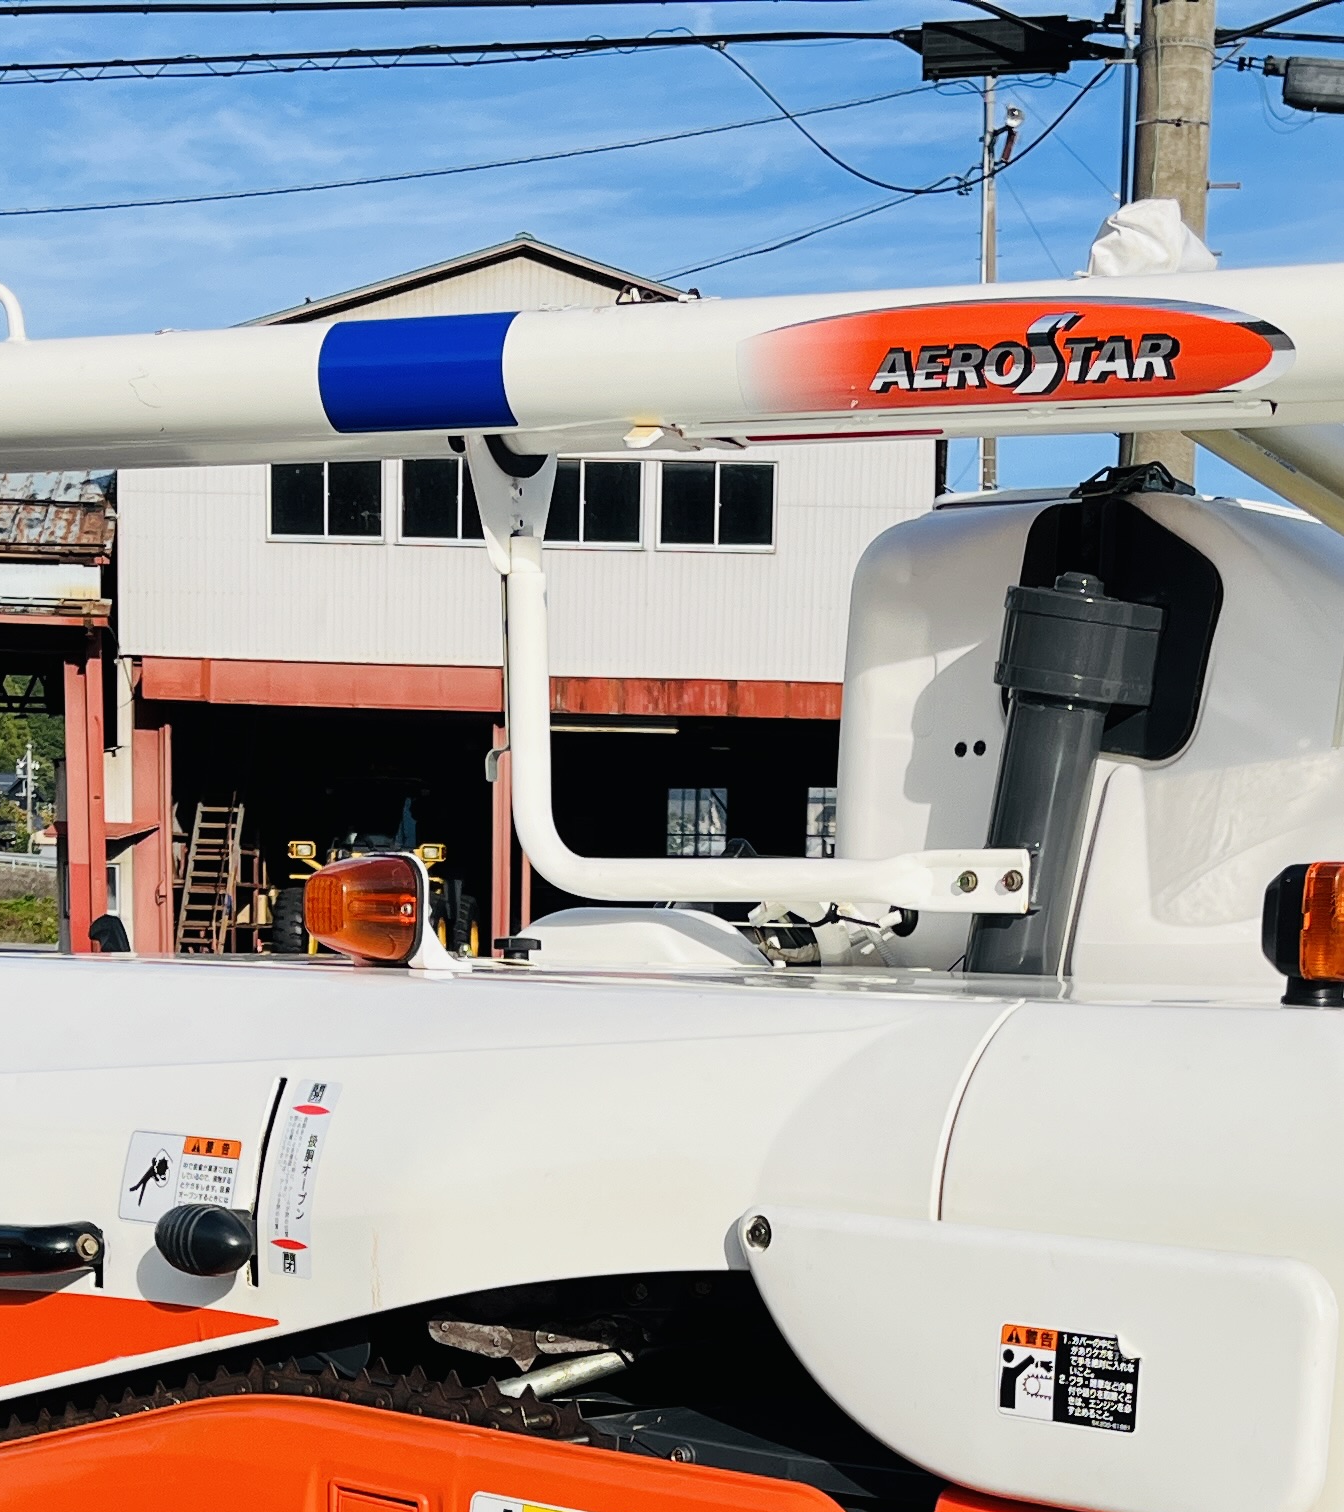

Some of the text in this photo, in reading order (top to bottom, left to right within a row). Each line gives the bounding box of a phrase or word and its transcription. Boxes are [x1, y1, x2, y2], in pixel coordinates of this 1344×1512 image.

[868, 312, 1181, 395] AEROSTAR
[205, 1141, 231, 1156] 警告
[1026, 1329, 1054, 1348] 警告
